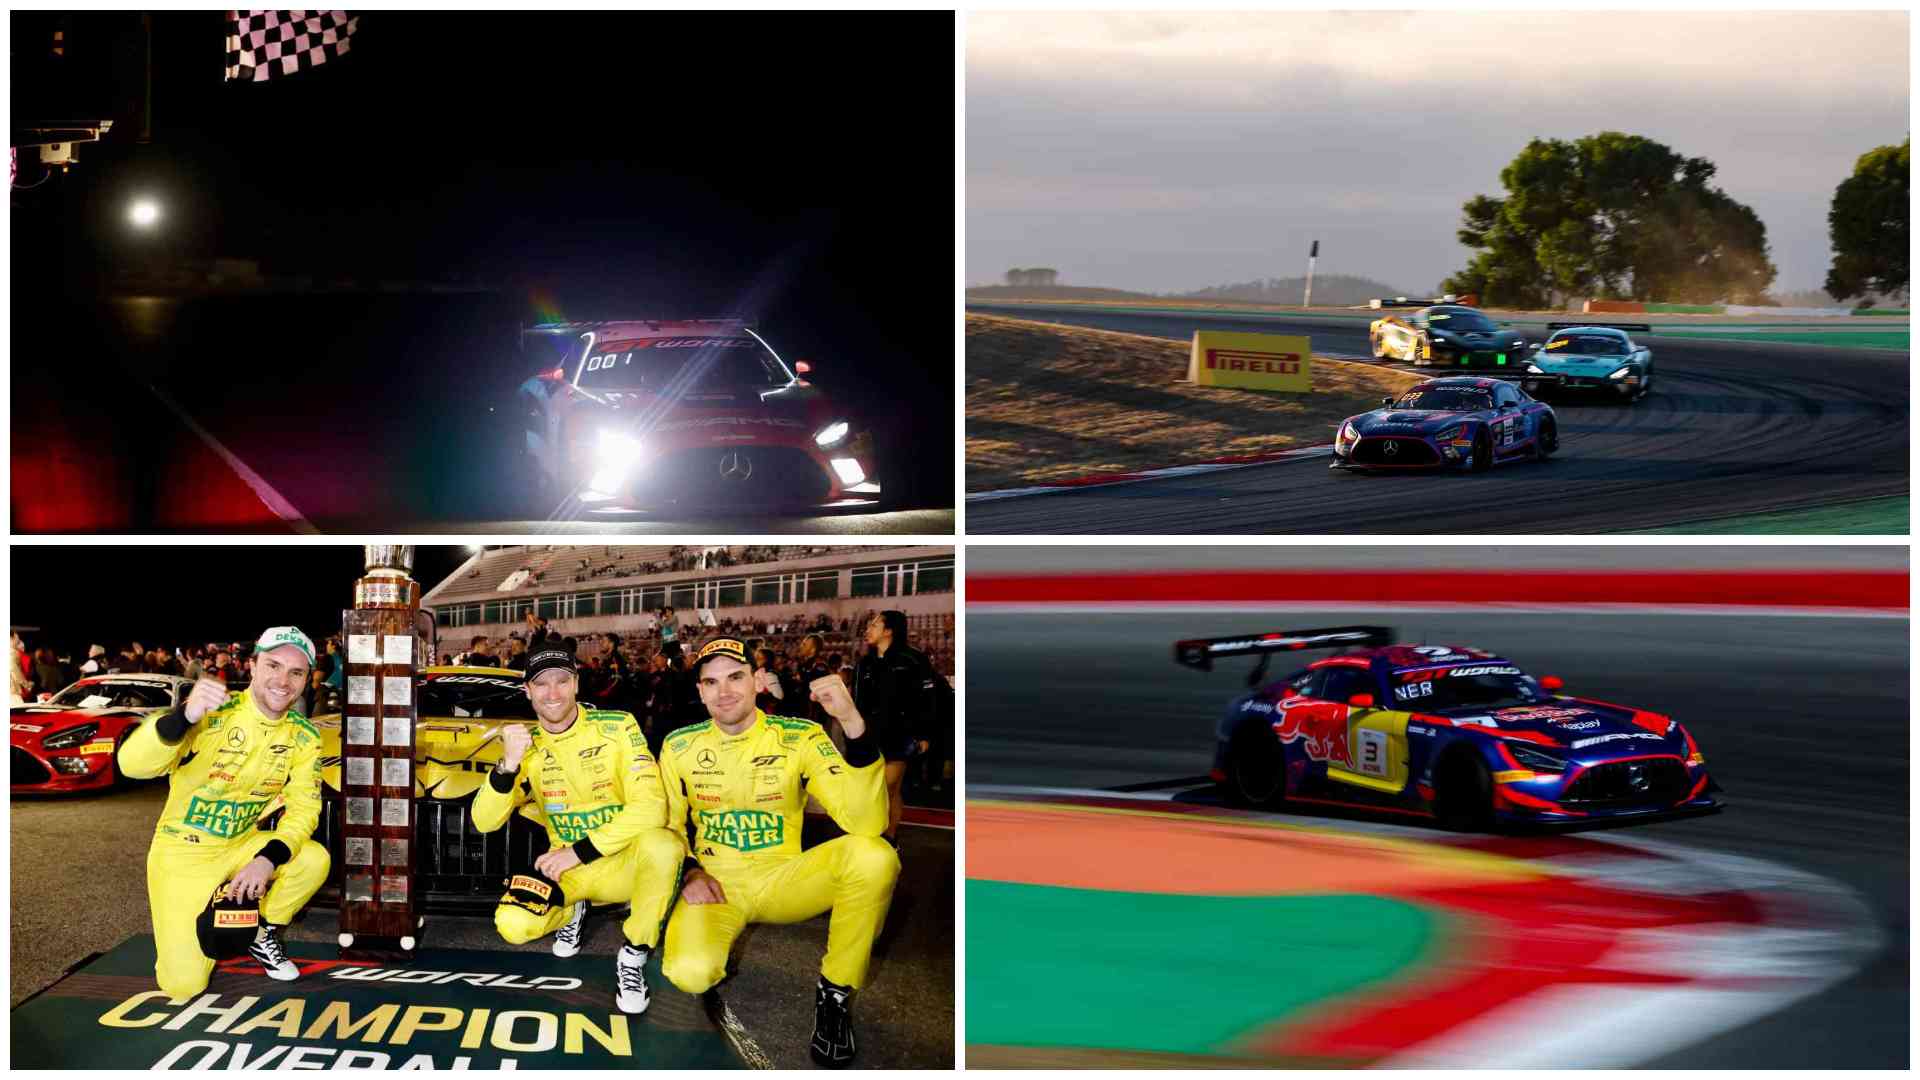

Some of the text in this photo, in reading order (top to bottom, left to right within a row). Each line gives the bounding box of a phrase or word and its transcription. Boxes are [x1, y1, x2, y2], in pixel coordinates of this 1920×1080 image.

[655, 339, 755, 349] WORLD
[1206, 349, 1300, 374] PIRELLI
[1449, 666, 1520, 677] WORLD
[194, 802, 266, 819] MANN
[553, 806, 624, 827] MANN
[701, 814, 778, 829] MANN
[708, 829, 779, 848] FILTER
[327, 967, 583, 991] WORLD
[98, 990, 634, 1056] CHAMPION
